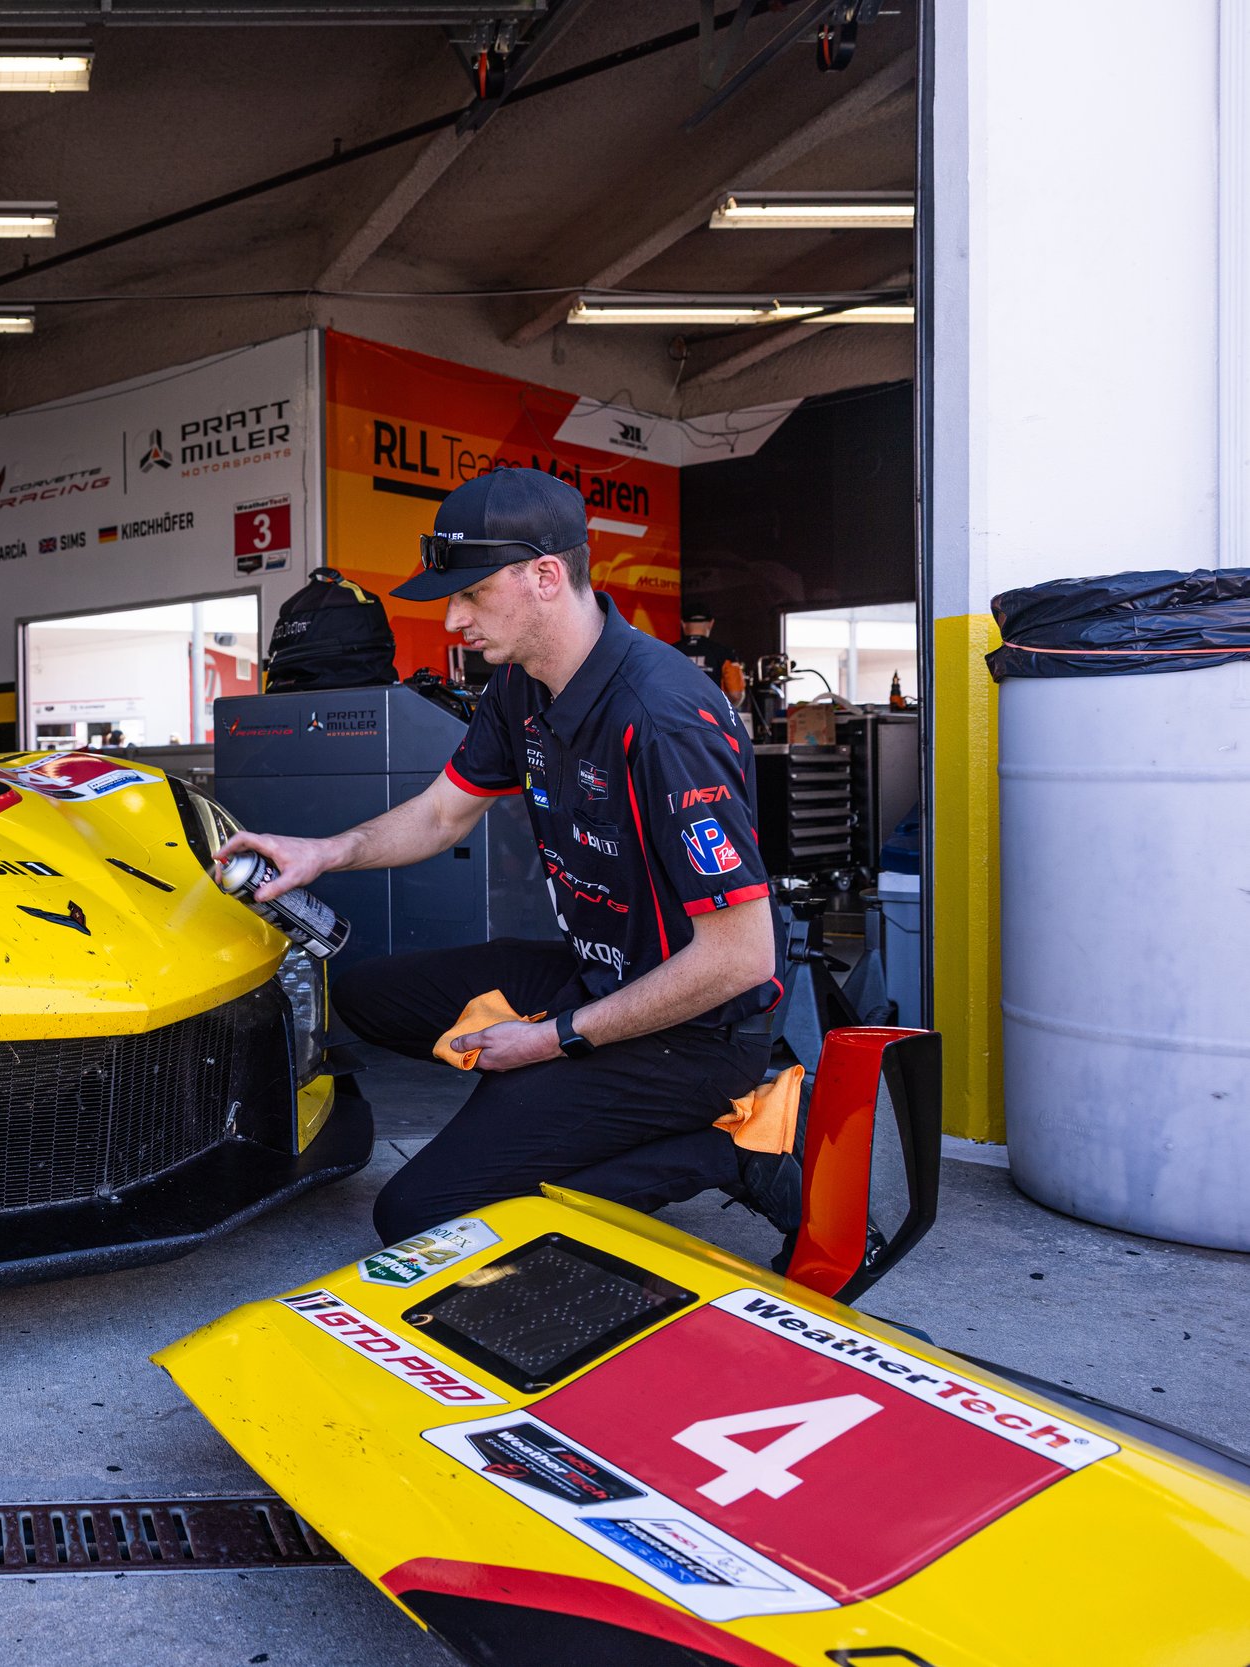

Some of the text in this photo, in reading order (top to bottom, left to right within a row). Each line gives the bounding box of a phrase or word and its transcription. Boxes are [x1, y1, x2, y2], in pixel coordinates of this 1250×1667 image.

[181, 400, 291, 442] PRATT
[181, 424, 291, 465] MILLER
[374, 420, 440, 477] RLL
[181, 448, 292, 478] MOTORSPORTS
[0, 476, 111, 509] RACING
[9, 467, 102, 493] CORVETTE
[61, 532, 86, 551] SIMS
[121, 512, 194, 540] KIRCHHÖFER
[253, 513, 272, 549] 3
[327, 710, 377, 720] PRATT
[327, 721, 377, 730] MILLER
[682, 785, 732, 809] IMSA
[396, 1236, 461, 1266] 24
[428, 1228, 472, 1248] ROLEX
[371, 1254, 418, 1281] DAYTONA
[314, 1311, 486, 1401] GTD PRO
[497, 1430, 609, 1499] WeatherTech
[558, 1453, 598, 1476] IMSA
[671, 1394, 885, 1508] 4
